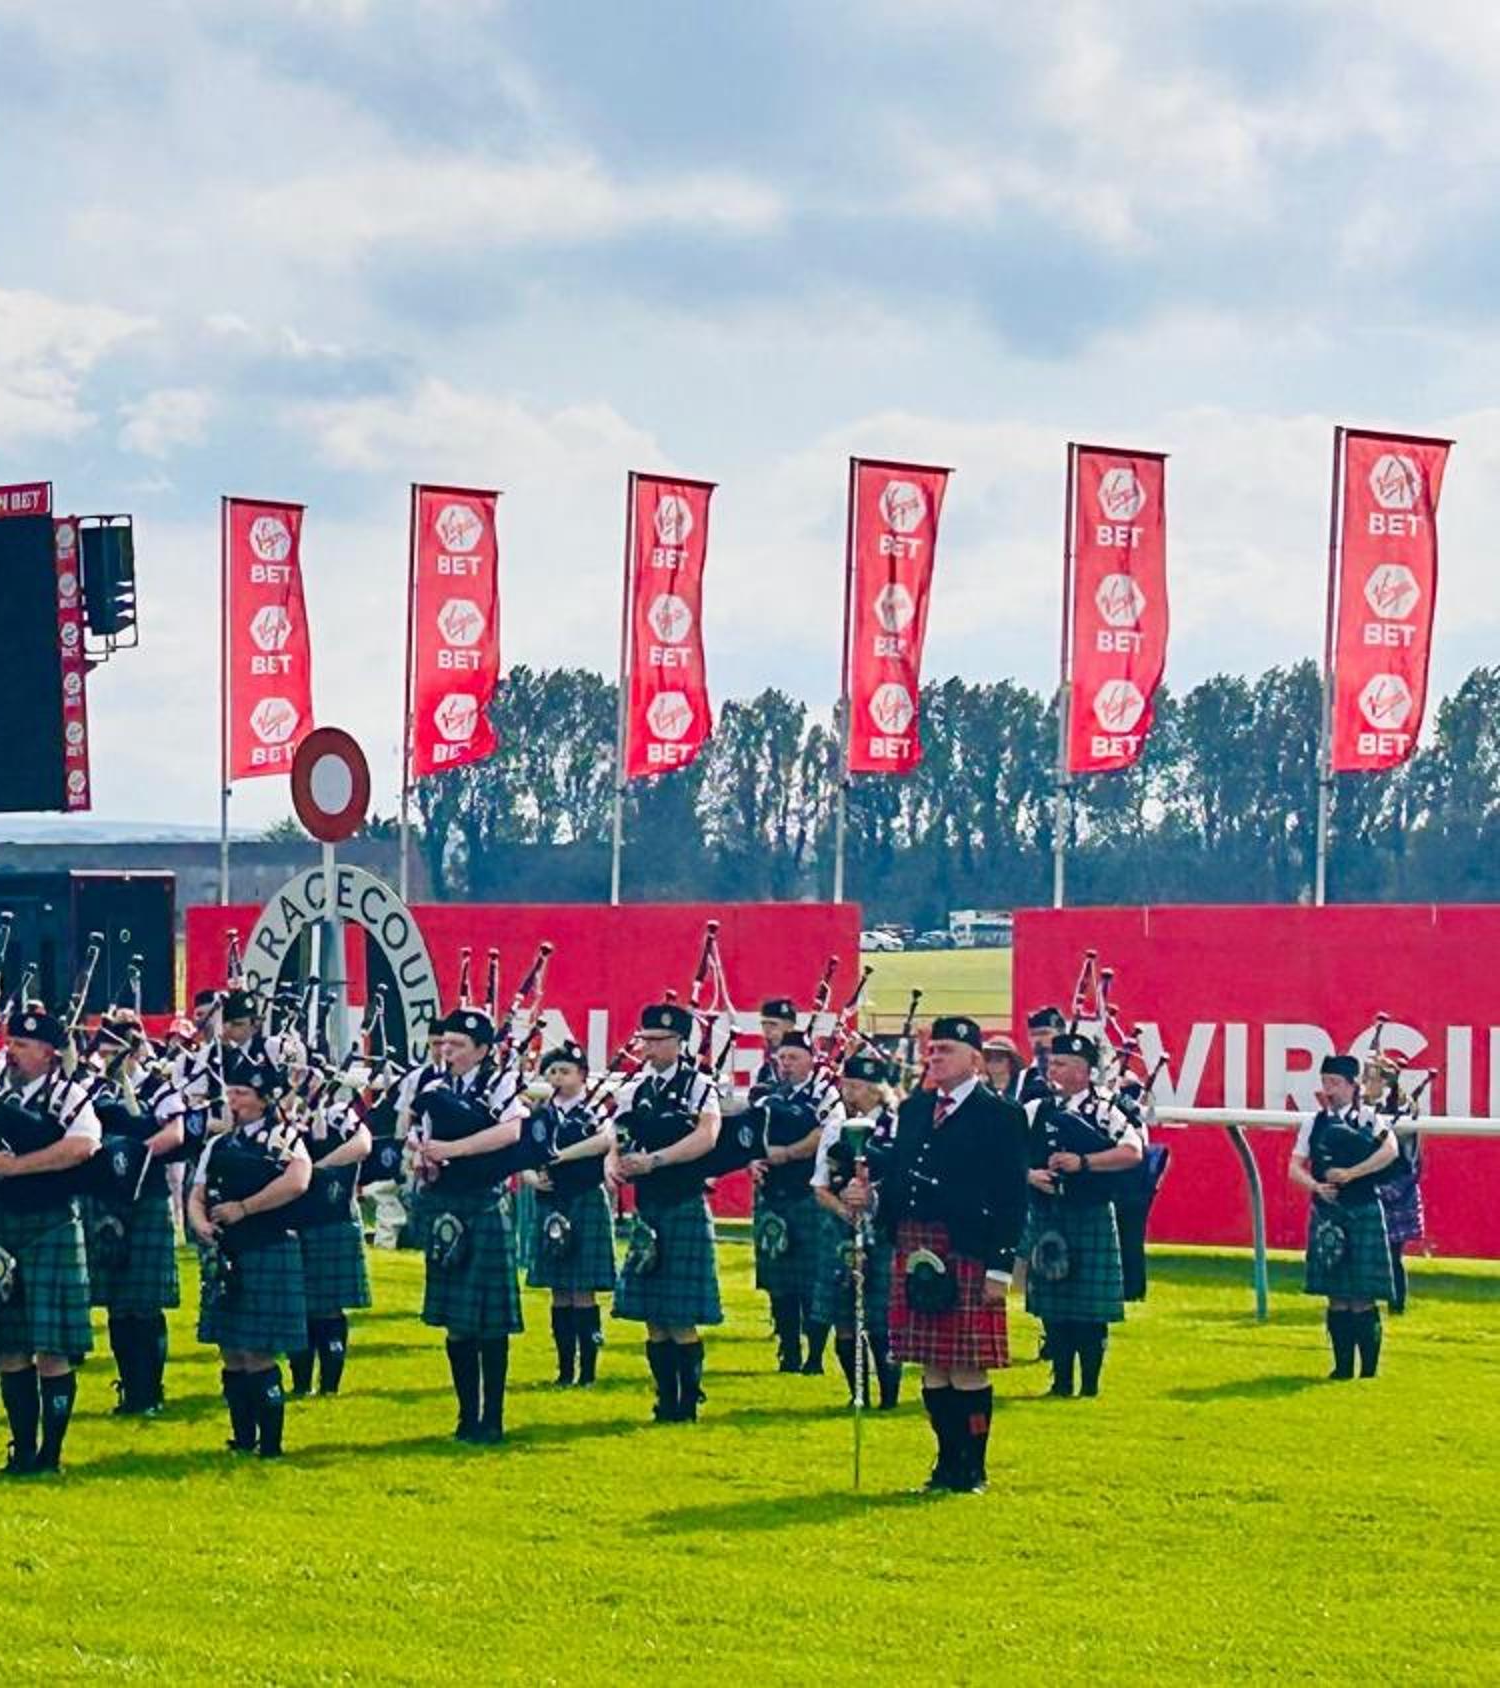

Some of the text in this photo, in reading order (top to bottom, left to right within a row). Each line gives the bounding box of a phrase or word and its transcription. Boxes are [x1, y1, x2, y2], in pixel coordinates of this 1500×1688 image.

[10, 489, 41, 511] BET
[1368, 514, 1422, 536] BET
[879, 534, 924, 559] BET
[1096, 525, 1143, 547] BET
[437, 556, 483, 575] BET
[651, 547, 688, 569] BET
[251, 565, 292, 583] BET
[1097, 632, 1144, 653] BET
[1363, 624, 1416, 646] BET
[252, 655, 292, 674] BET
[437, 650, 482, 669] BET
[649, 646, 693, 667] BET
[252, 744, 296, 765] BET
[647, 744, 692, 763] BET
[869, 737, 911, 758] BET
[1091, 736, 1140, 757] BET
[1357, 733, 1411, 756] BET
[255, 870, 437, 1065] RACECOURS
